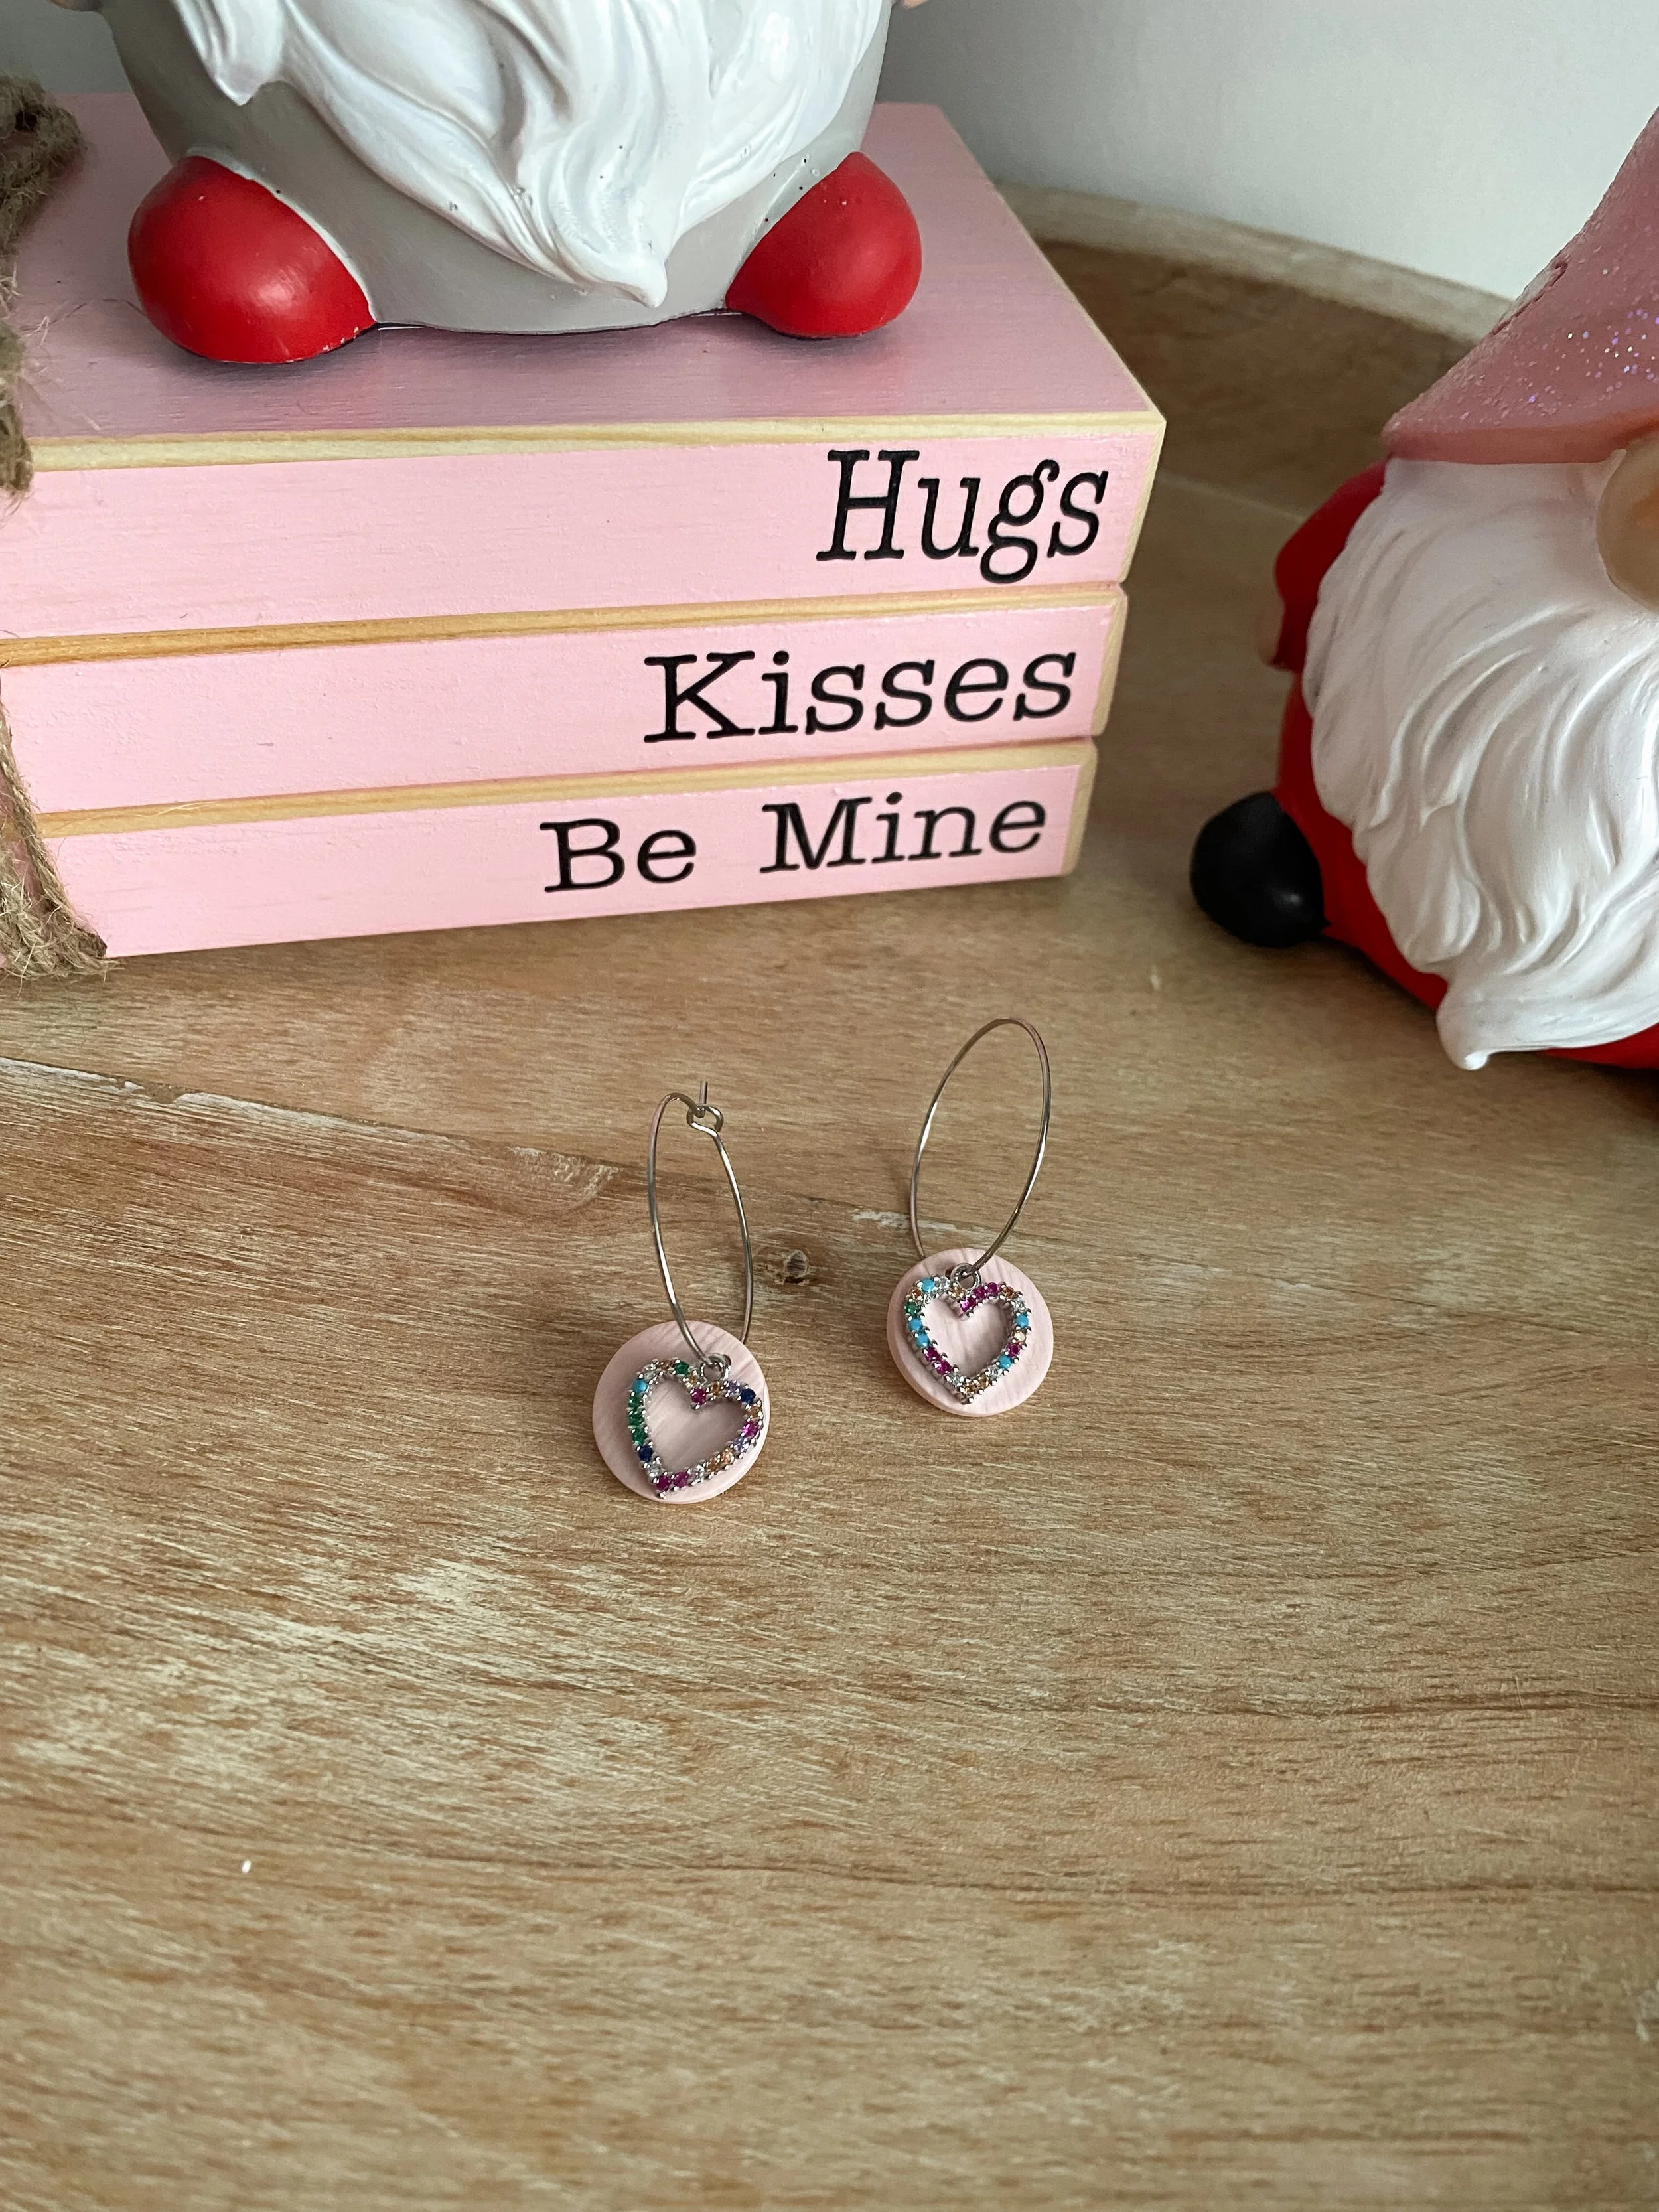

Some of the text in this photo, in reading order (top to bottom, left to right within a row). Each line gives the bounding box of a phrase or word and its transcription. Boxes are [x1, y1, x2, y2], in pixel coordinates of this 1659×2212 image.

[816, 449, 1109, 584] Hugs
[644, 650, 1076, 743] Kisses
[539, 792, 1046, 893] Be Mine
